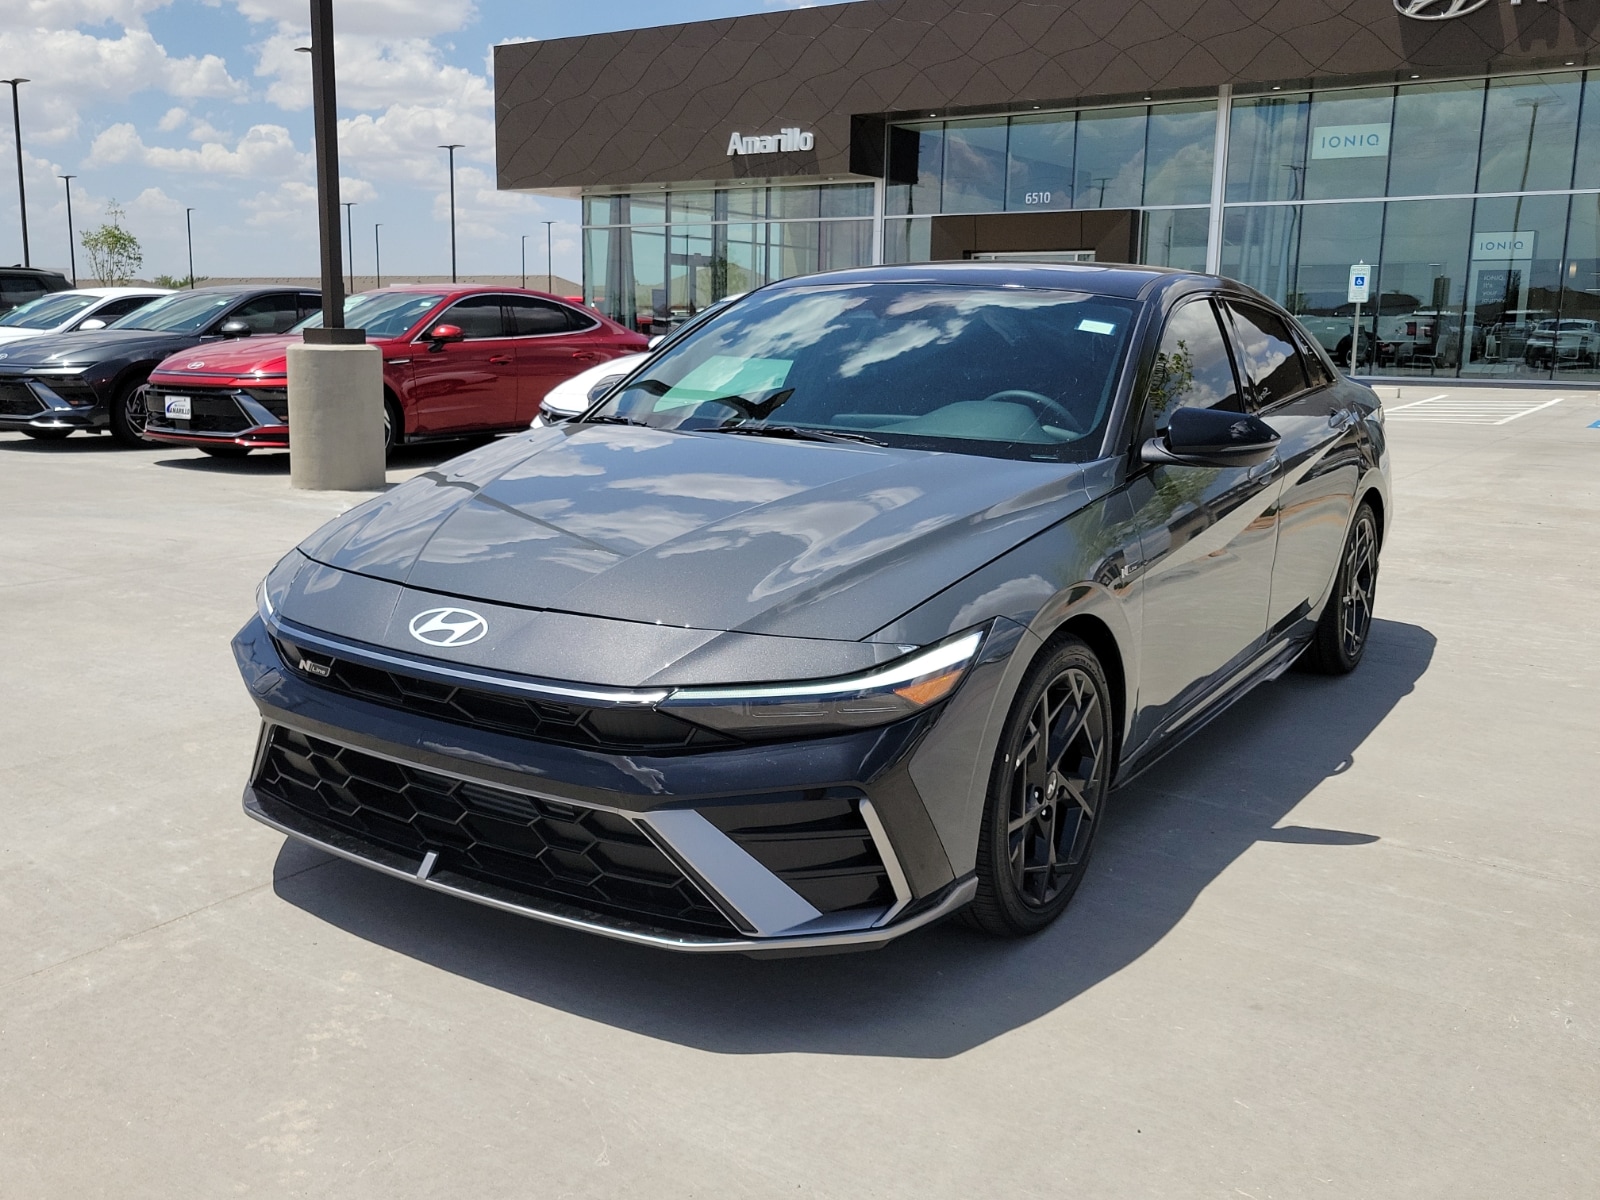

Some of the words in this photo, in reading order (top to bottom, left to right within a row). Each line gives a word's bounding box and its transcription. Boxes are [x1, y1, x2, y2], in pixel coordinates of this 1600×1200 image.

[726, 127, 814, 156] Amarillo
[1322, 133, 1379, 149] IONIQ
[1025, 191, 1051, 204] 6510
[1480, 241, 1524, 251] IONIQ
[299, 659, 311, 672] N
[312, 666, 326, 674] Line
